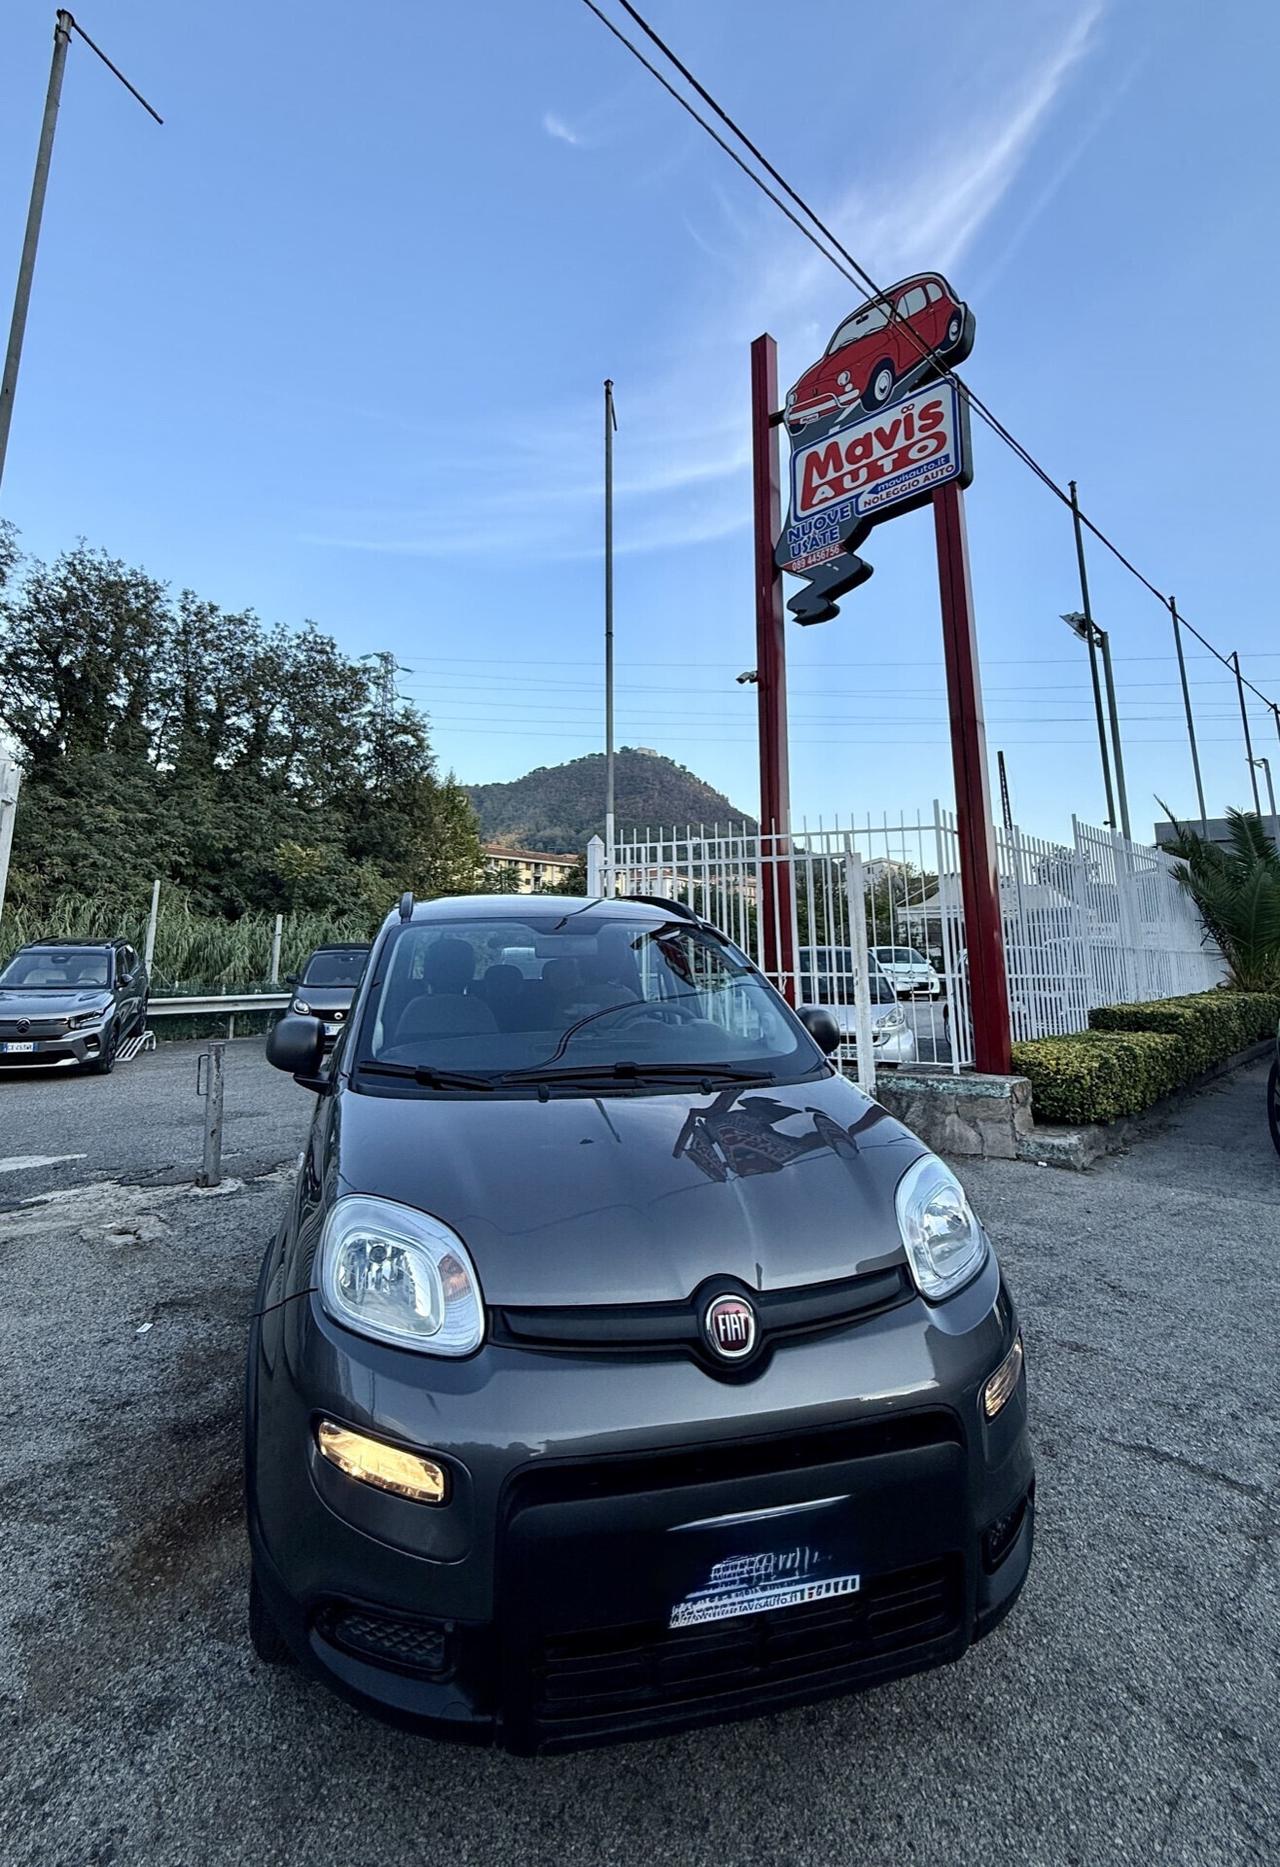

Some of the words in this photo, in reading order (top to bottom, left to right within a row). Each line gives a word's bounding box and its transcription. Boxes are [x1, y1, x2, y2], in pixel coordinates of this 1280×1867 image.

[811, 436, 942, 505] AUTO
[864, 480, 920, 508] NOLEGGIO
[922, 464, 955, 484] AUTO
[877, 457, 946, 490] mavisauto.it
[787, 503, 851, 544] NUOVE
[791, 525, 840, 558] USATE
[717, 1313, 750, 1342] FIAT
